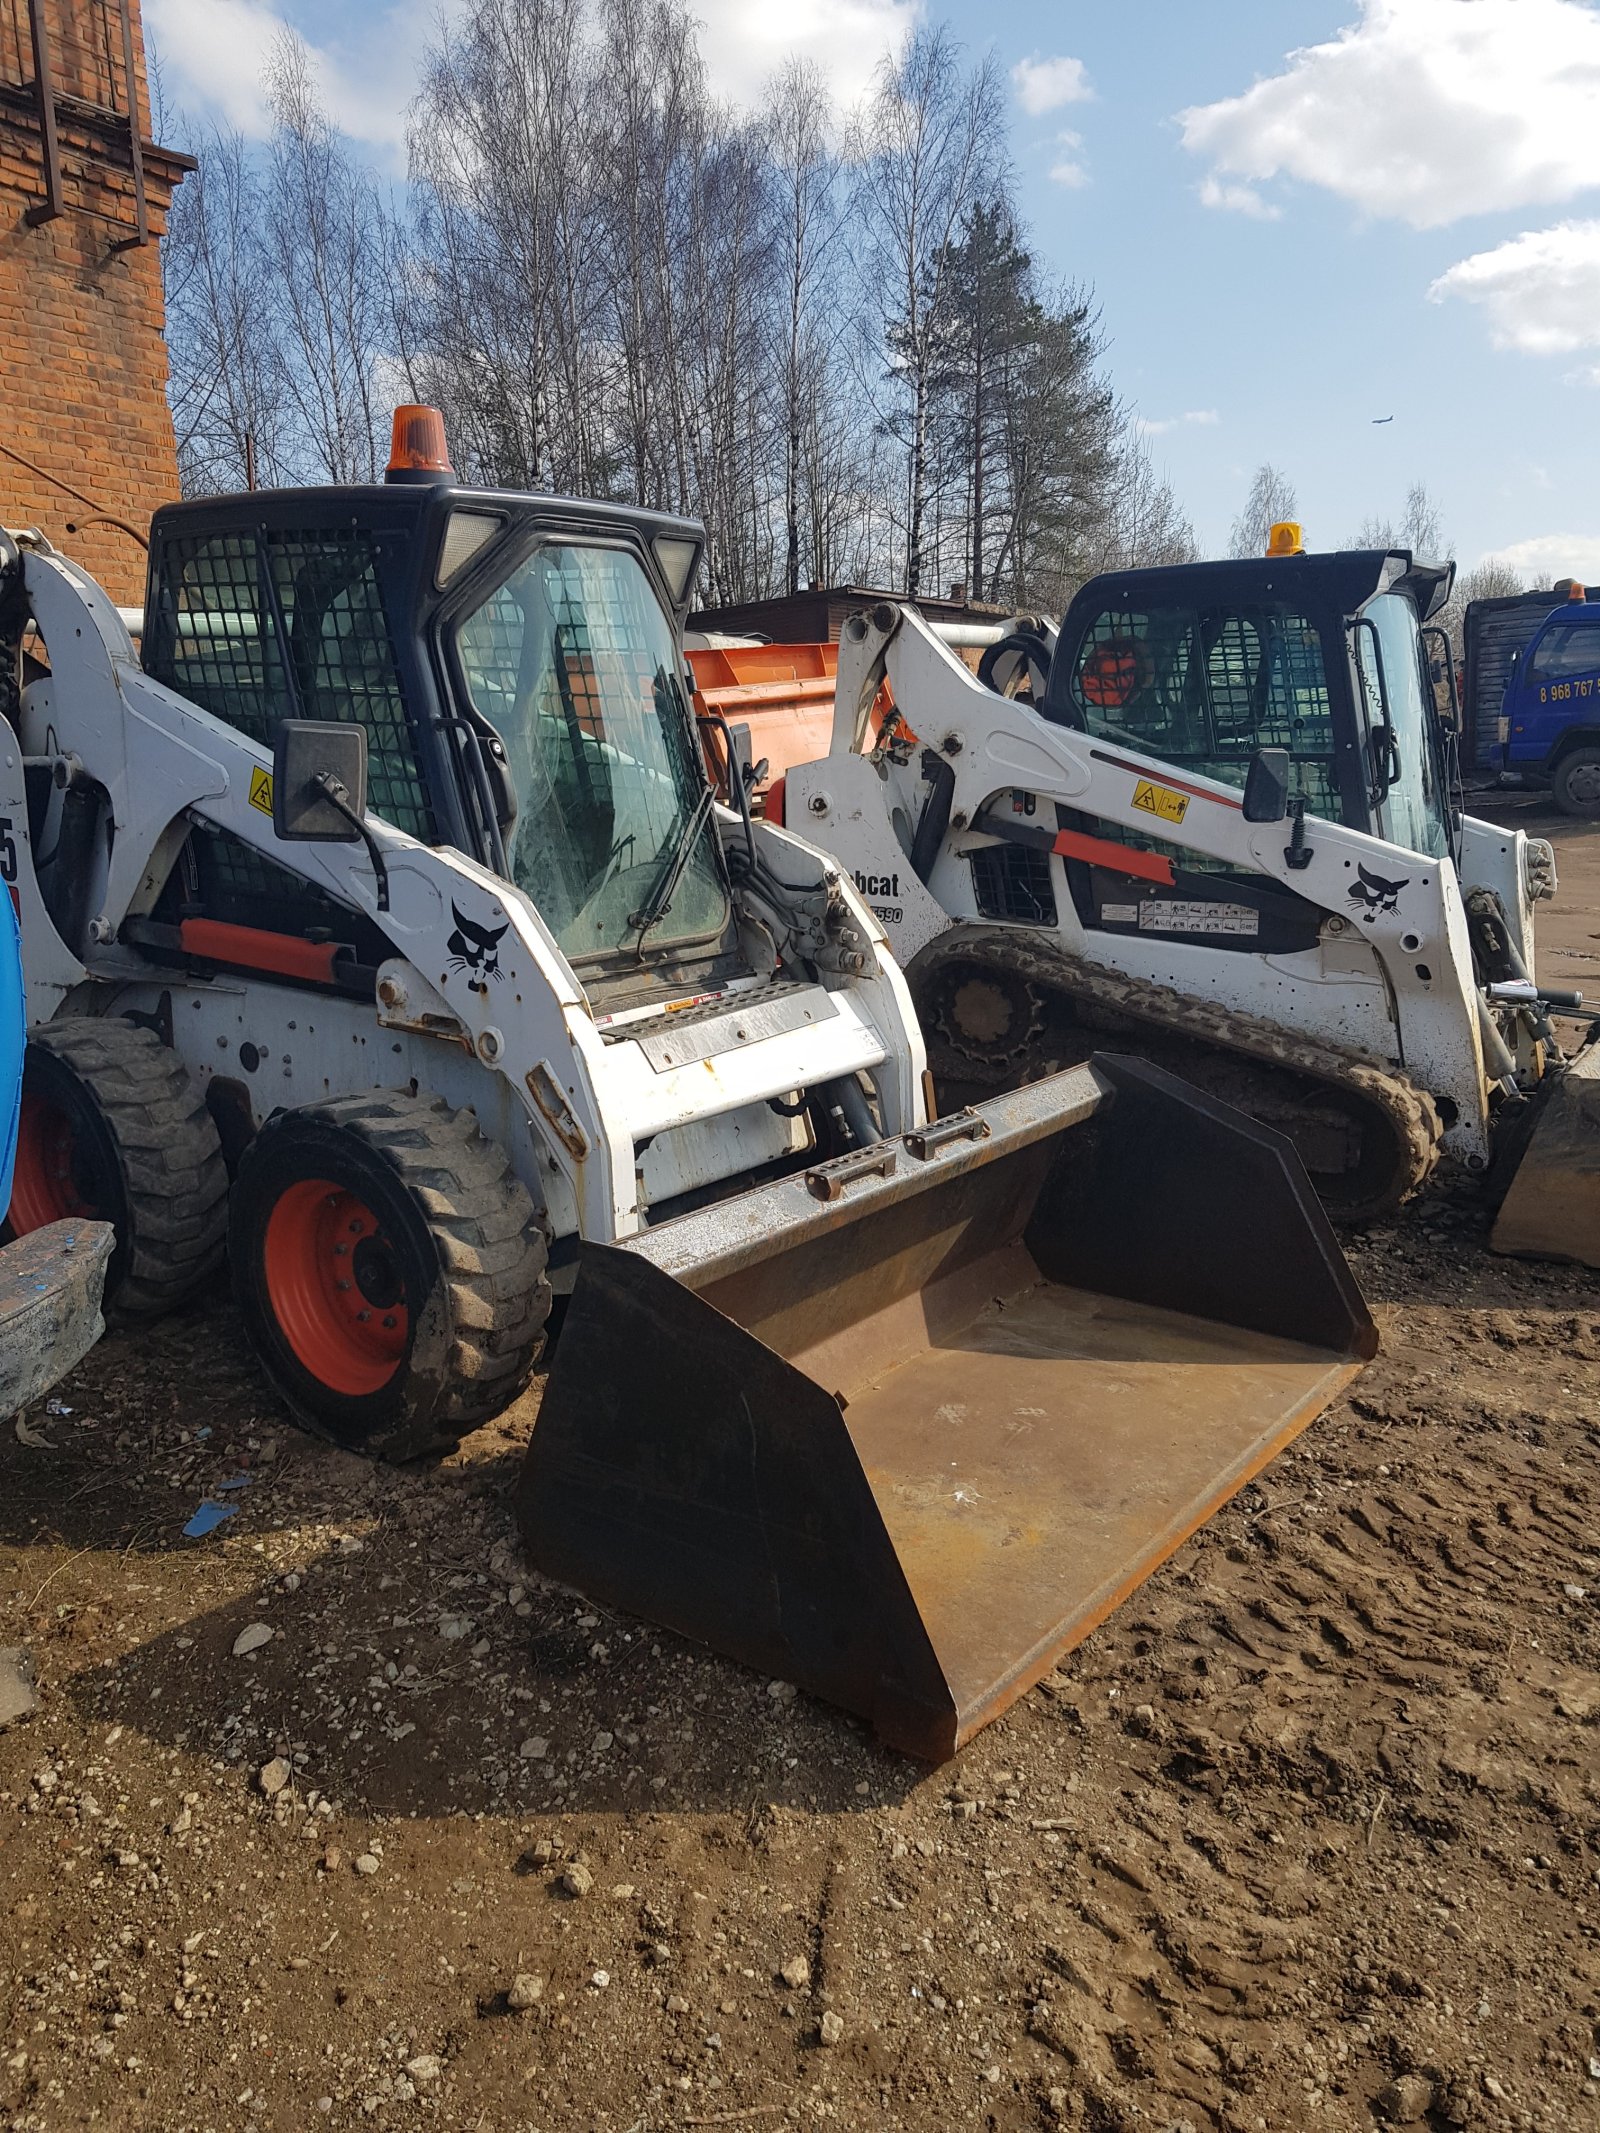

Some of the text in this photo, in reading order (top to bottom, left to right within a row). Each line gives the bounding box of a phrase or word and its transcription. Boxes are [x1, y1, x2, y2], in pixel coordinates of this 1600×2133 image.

[1540, 687, 1547, 703] 8
[1551, 683, 1571, 701] 968
[1573, 679, 1594, 697] 767
[849, 870, 899, 898] bcat
